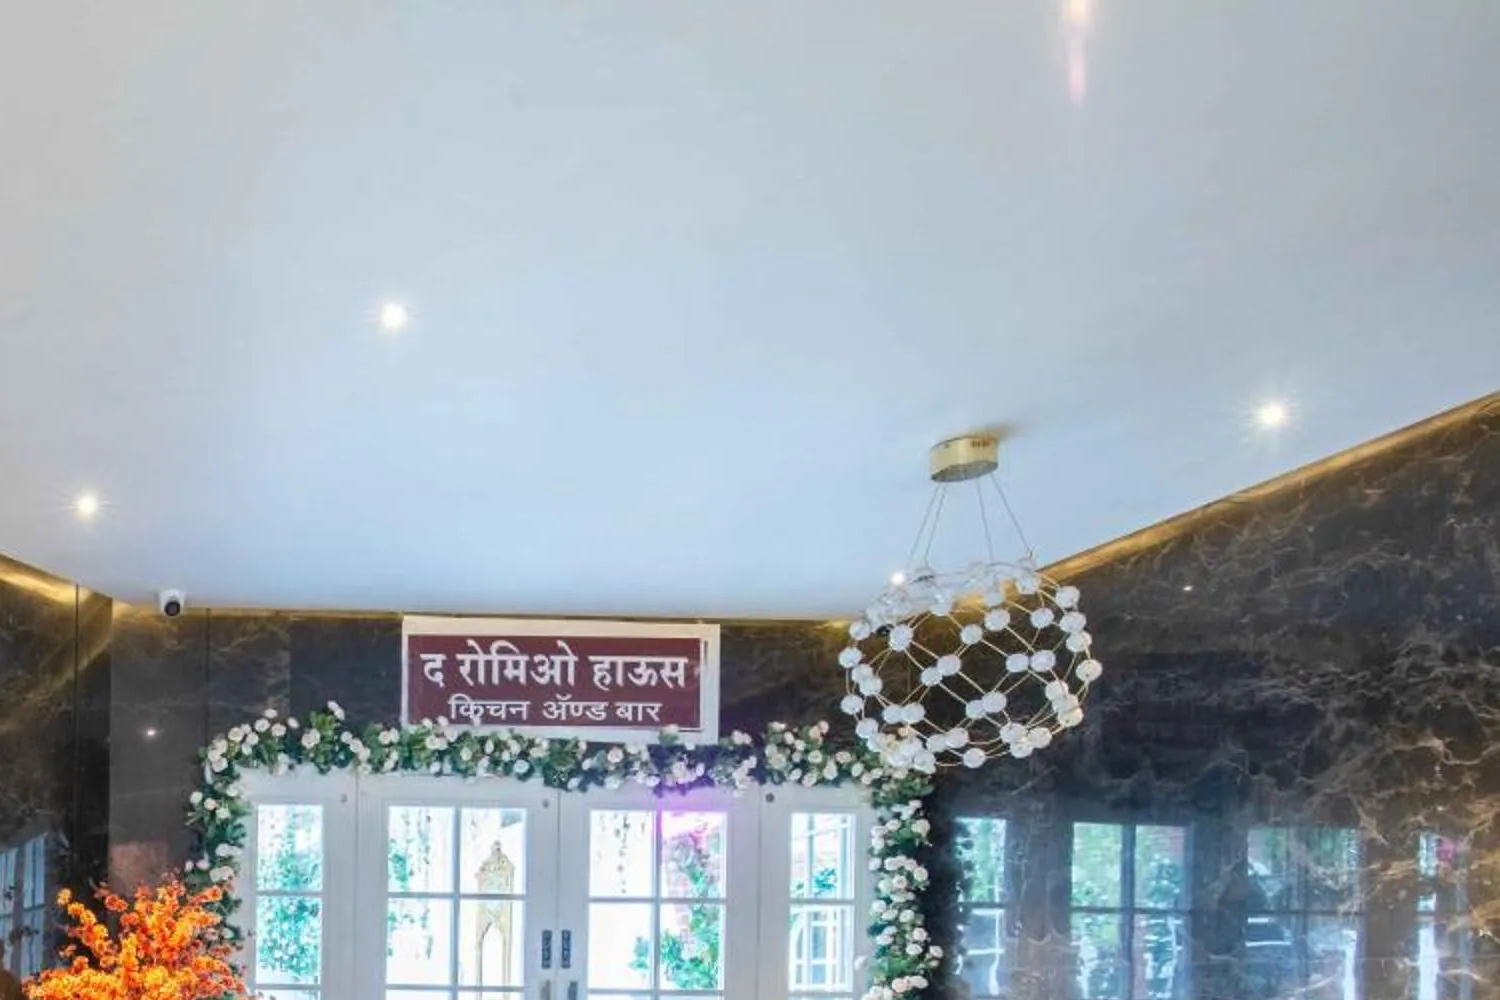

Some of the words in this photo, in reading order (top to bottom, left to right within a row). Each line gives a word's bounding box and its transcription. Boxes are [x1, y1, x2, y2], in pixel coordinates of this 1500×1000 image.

[419, 653, 446, 687] द
[455, 638, 578, 686] रोमिओ
[588, 655, 689, 691] हाऊस
[447, 693, 531, 721] किचन
[614, 702, 663, 722] बार
